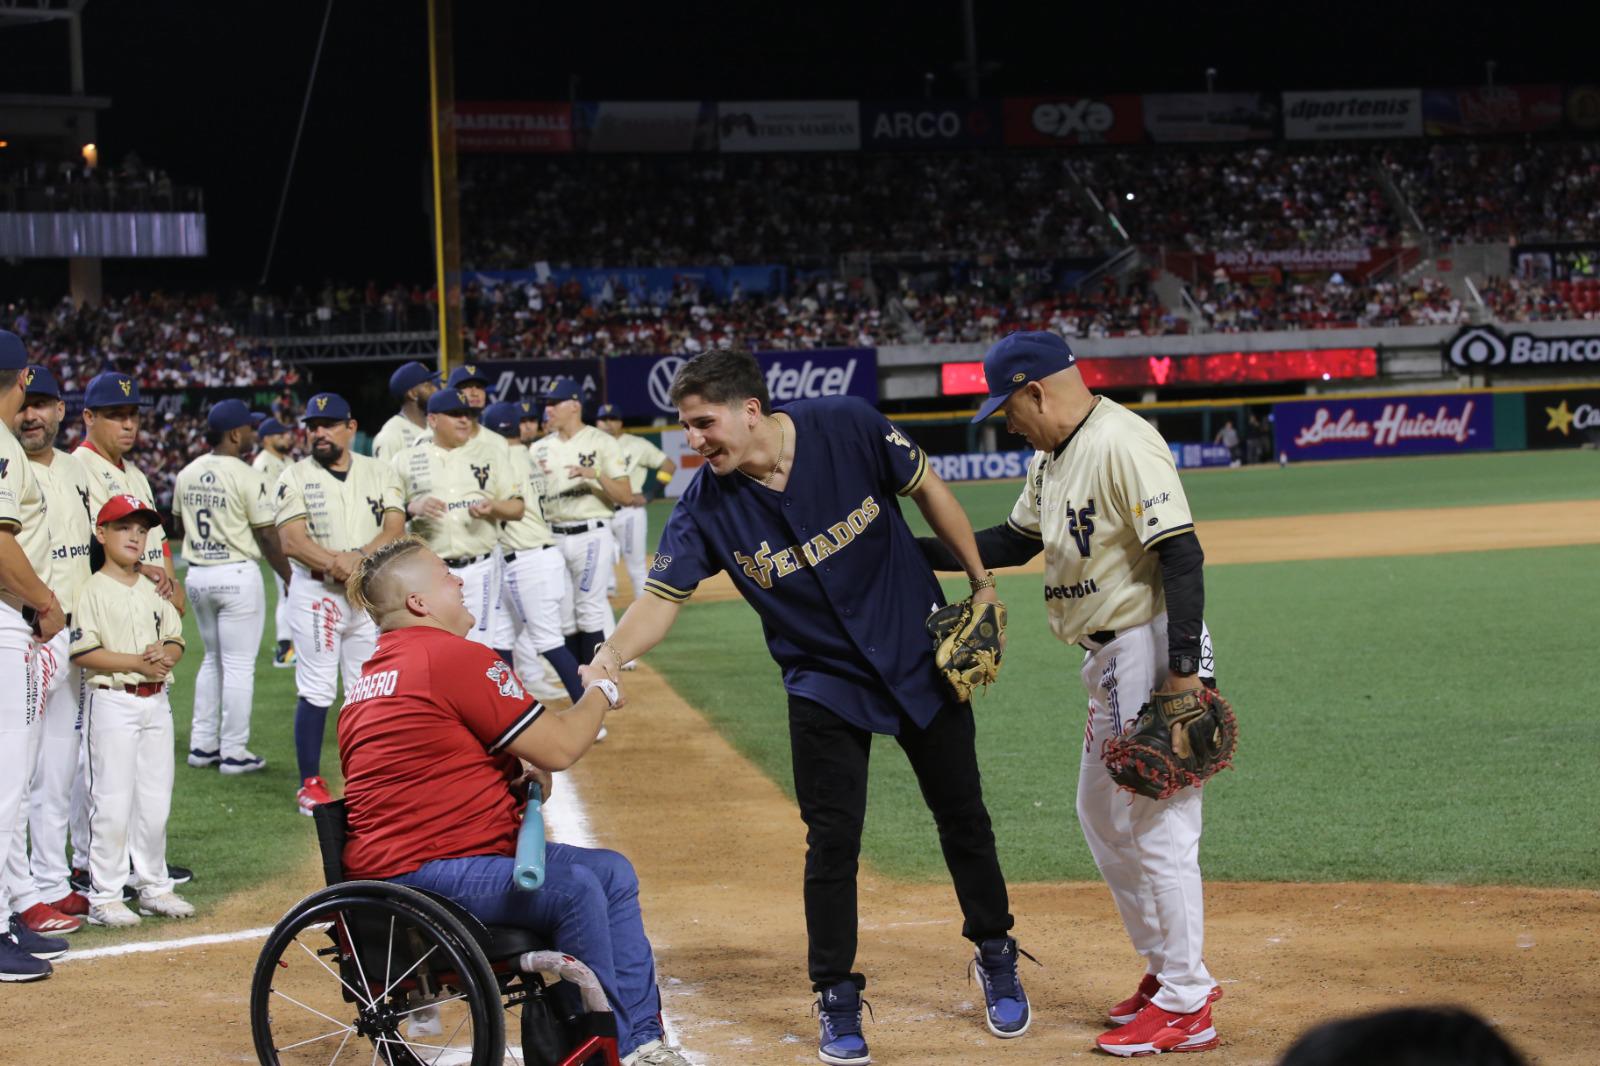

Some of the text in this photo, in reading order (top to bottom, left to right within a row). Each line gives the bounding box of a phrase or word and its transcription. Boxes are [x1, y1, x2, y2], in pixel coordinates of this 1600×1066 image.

[454, 113, 571, 132] BASKETBALL
[1031, 98, 1115, 137] exa
[1289, 98, 1410, 121] dportenis
[871, 110, 961, 139] ARCO
[1510, 335, 1600, 363] Banco
[767, 358, 858, 399] telcel
[1296, 401, 1474, 445] Salsa Huichol
[183, 493, 227, 510] HERRERA
[196, 508, 212, 540] 6
